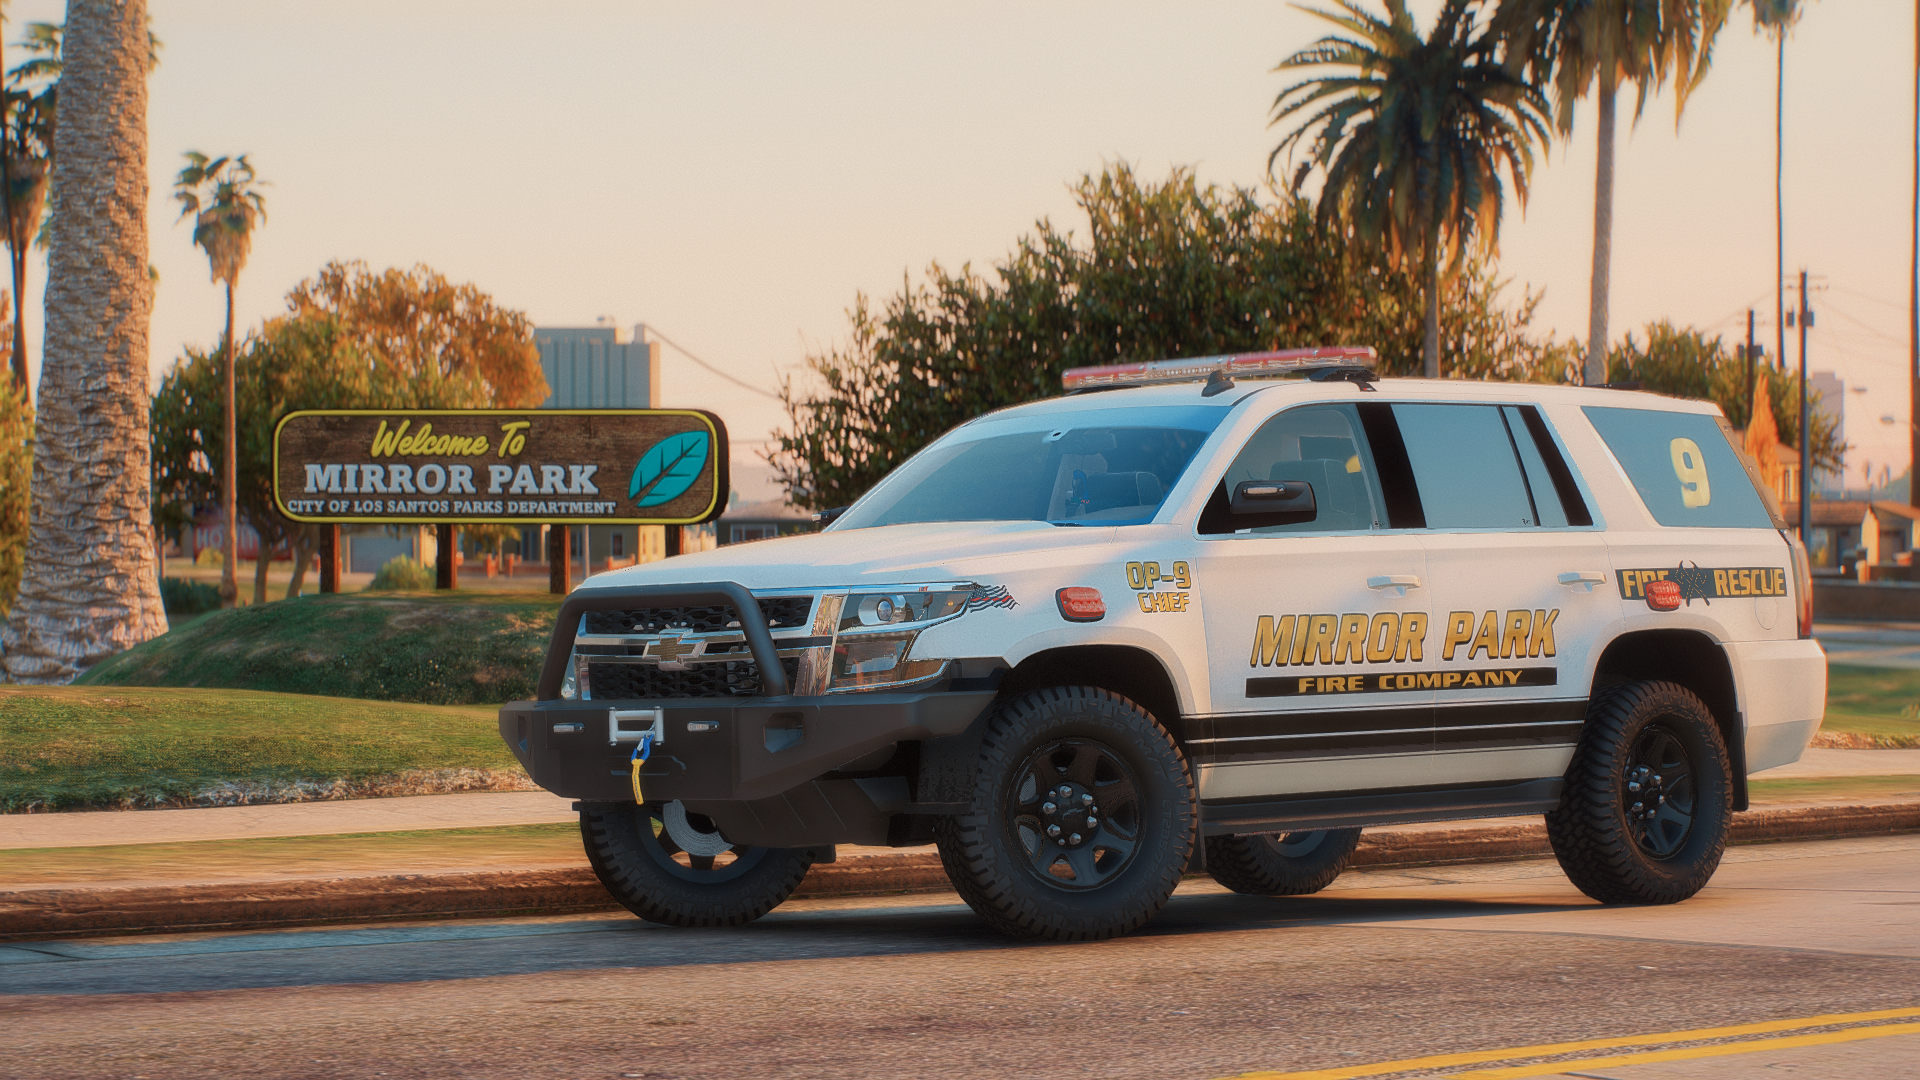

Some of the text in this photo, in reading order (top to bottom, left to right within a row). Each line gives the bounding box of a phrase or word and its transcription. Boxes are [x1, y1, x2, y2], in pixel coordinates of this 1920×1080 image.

[370, 420, 531, 458] Welcome To
[304, 464, 599, 495] MIRROR PARK
[1670, 438, 1711, 508] 9
[287, 500, 616, 515] CITY OF LOS SANTOS PARKS DEPARTMENT
[1126, 561, 1192, 589] OP-9
[1713, 568, 1786, 596] RESCUE
[1137, 592, 1191, 614] CHIEF
[1250, 609, 1560, 667] MIRROR PARK
[1298, 670, 1523, 694] FIRE COMPANY
